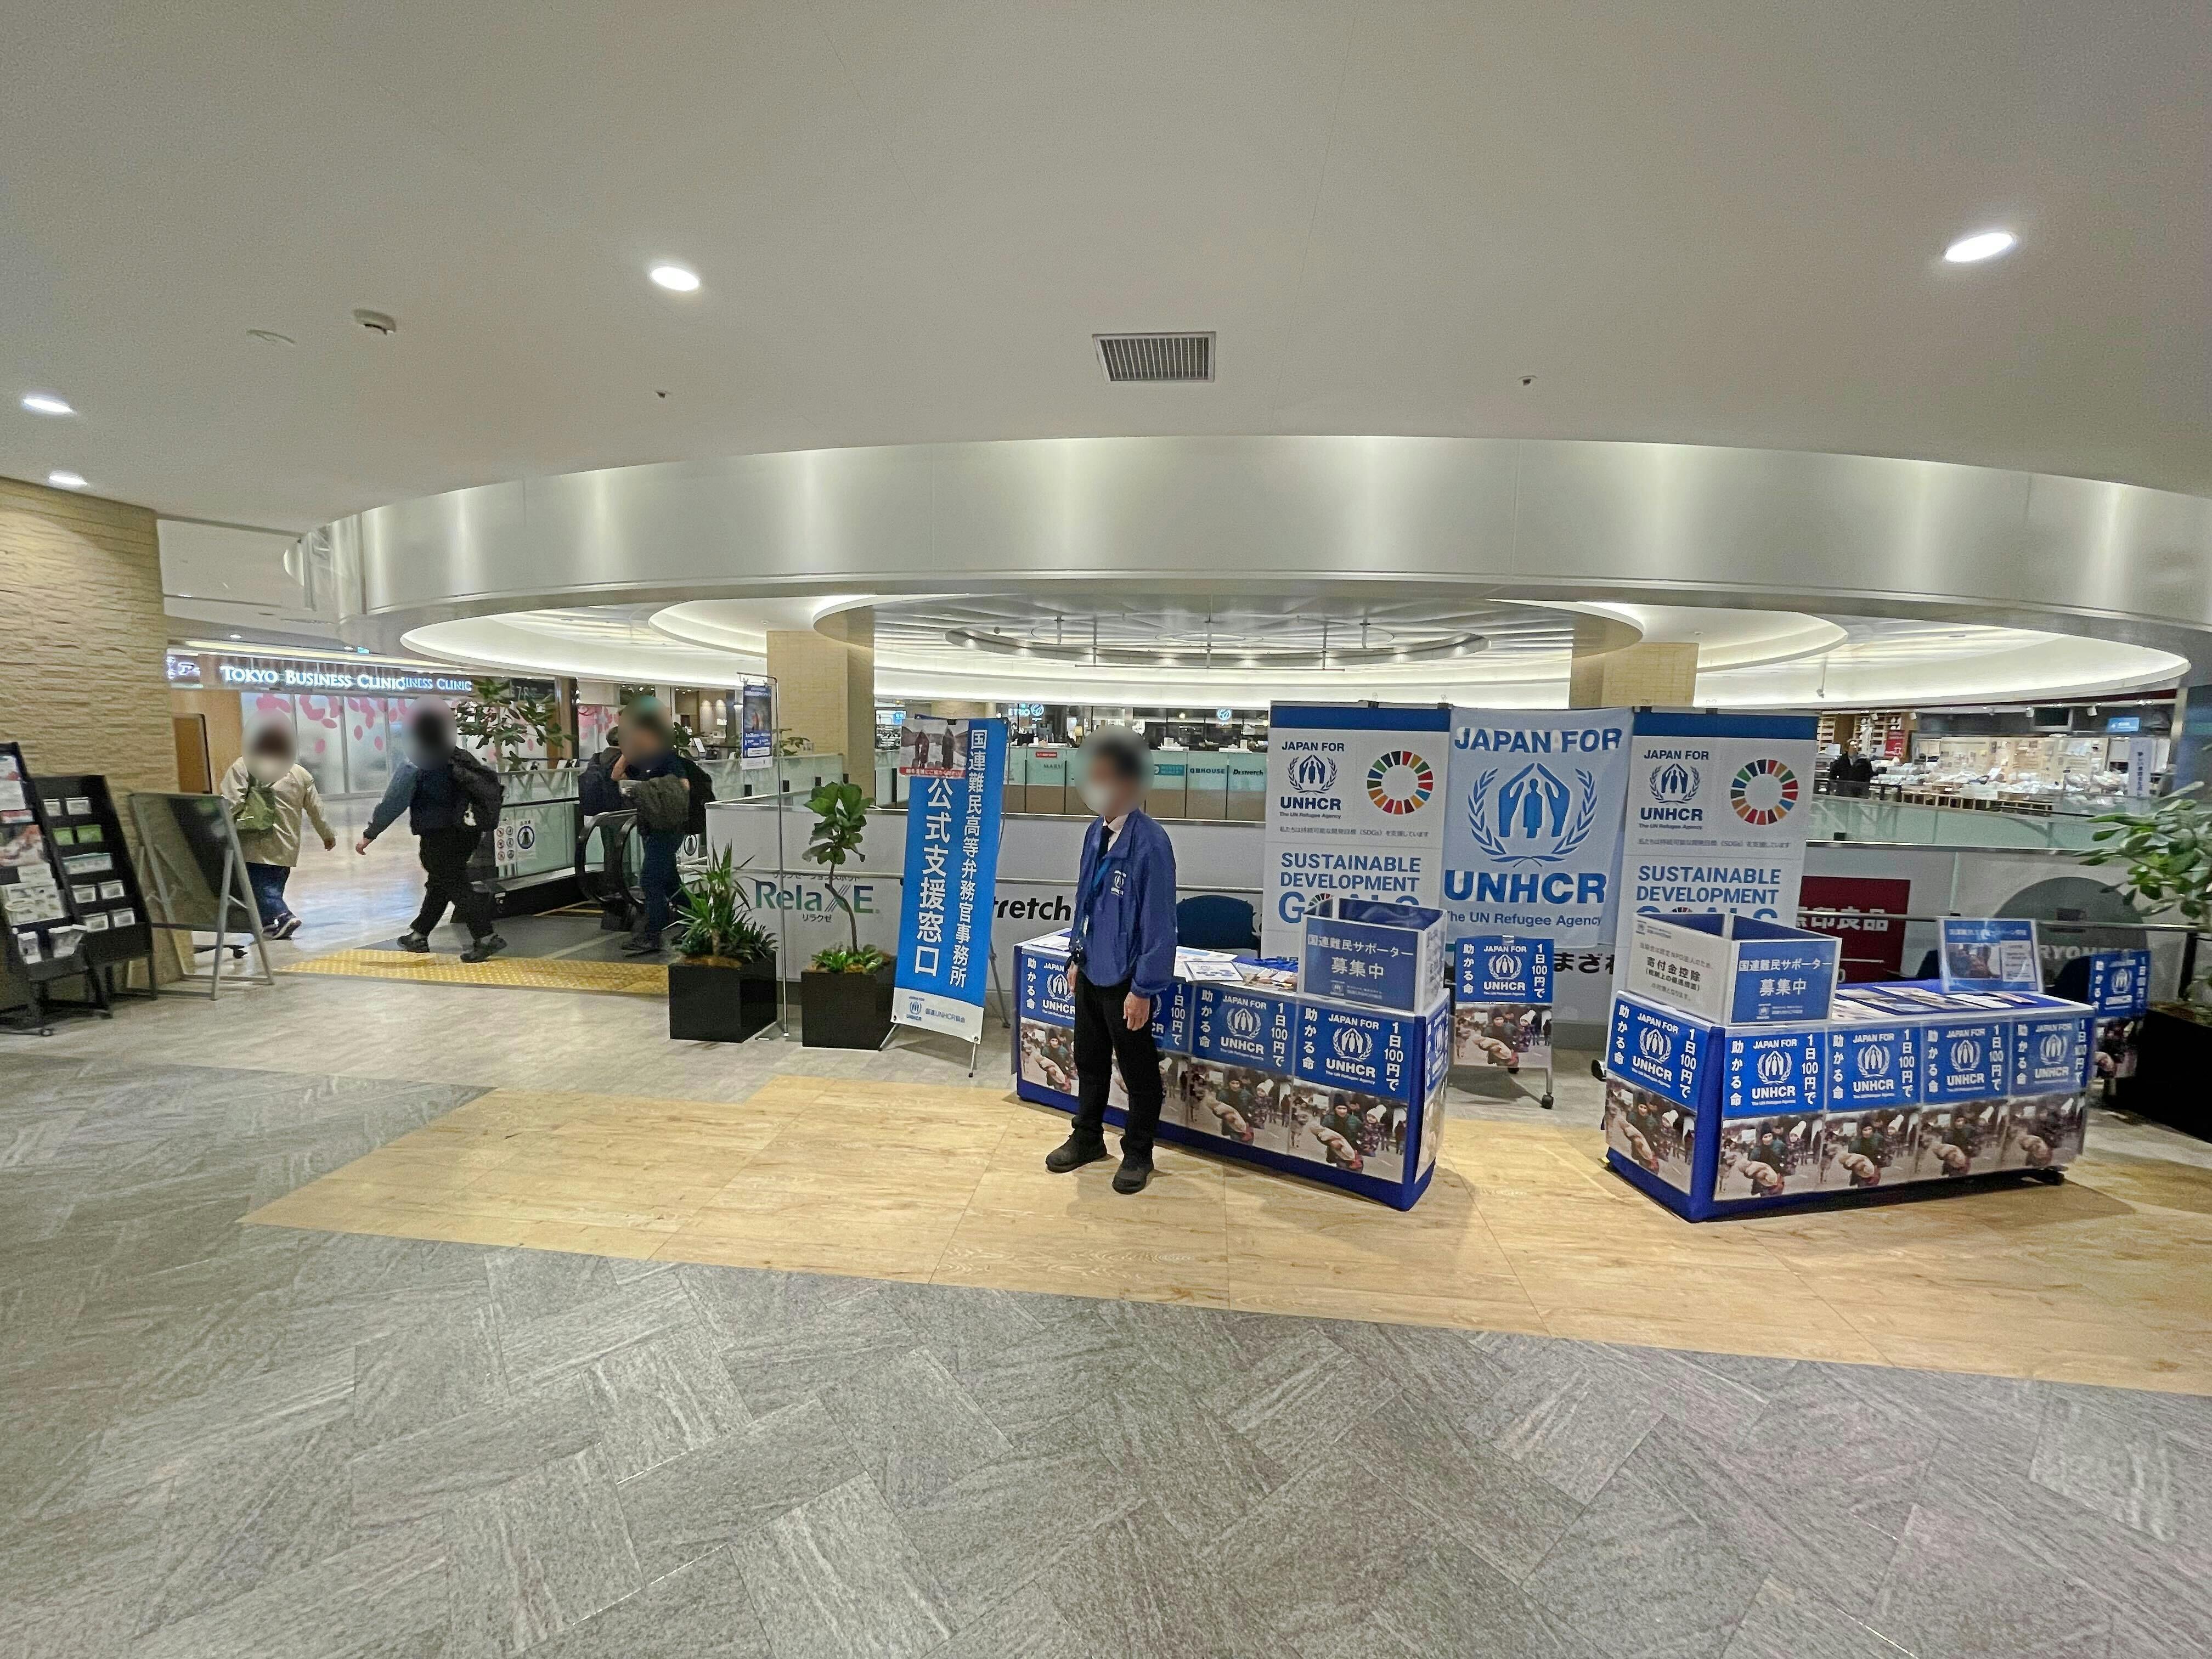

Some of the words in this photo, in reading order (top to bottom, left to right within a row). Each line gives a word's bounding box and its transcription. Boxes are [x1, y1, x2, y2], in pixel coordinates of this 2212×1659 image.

[219, 664, 279, 683] TOKYO
[285, 669, 352, 687] BUSINESS
[1282, 741, 1318, 751] JAPAN
[1322, 742, 1345, 752] FOR
[1454, 728, 1551, 753] JAPAN
[1562, 728, 1622, 753] FOR
[1644, 750, 1681, 759] JAPAN
[1685, 751, 1709, 760] FOR
[1280, 797, 1341, 810] UNHCR
[1640, 807, 1703, 821] UNHCR
[949, 729, 988, 988] 国連難民高等弁務官事務所
[1281, 852, 1421, 872] SUSTAINABLE
[914, 778, 953, 977] 公式支援窓口
[1280, 872, 1420, 892] DEVELOPMENT
[1638, 865, 1781, 884] SUSTAINABLE
[1444, 870, 1607, 904] UNHCR
[1637, 886, 1779, 904] DEVELOPMENT
[802, 913, 832, 923] リラクゼ
[1470, 912, 1489, 923] UN
[1494, 913, 1551, 927] Refugee
[1556, 915, 1601, 927] Agency
[1307, 934, 1414, 957] 国連難民サポーター
[1043, 962, 1065, 972] JAPAN
[1331, 956, 1384, 979] 募集中
[1463, 944, 1475, 994] 助かる命
[1532, 944, 1548, 998] 1日100円で
[1738, 958, 1832, 972] 国連難民サポーター
[1483, 981, 1525, 991] UNHCR
[1760, 978, 1807, 996] 募集中
[1042, 999, 1075, 1014] UNHCR
[1222, 995, 1248, 1006] JAPAN
[1250, 1000, 1267, 1010] FOR
[1199, 989, 1213, 1048] 助かる命
[1328, 1014, 1358, 1026] JAPAN
[1360, 1019, 1379, 1030] FOR
[1637, 1013, 1661, 1028] JAPAN
[1662, 1022, 1679, 1034] FOR
[1271, 1002, 1288, 1067] 1日100円で
[1302, 1008, 1317, 1070] 助かる命
[1614, 1005, 1630, 1065] 助かる命
[1753, 1040, 1779, 1049] JAPAN
[1781, 1039, 1797, 1047] FOR
[1853, 1035, 1877, 1043] JAPAN
[1878, 1033, 1895, 1041] FOR
[1220, 1036, 1264, 1054] UNHCR
[1384, 1022, 1404, 1092] 1日100円で
[1679, 1028, 1697, 1098] 1日100円で
[1899, 1029, 1915, 1097] 1日100円で
[1326, 1058, 1375, 1078] UNHCR
[1633, 1056, 1672, 1081] UNHCR
[1730, 1040, 1744, 1107] 助かる命
[1802, 1034, 1819, 1104] 1日100円で
[1853, 1079, 1894, 1092] UNHCR
[1947, 1073, 1984, 1086] UNHCR
[1752, 1086, 1796, 1099] UNHCR
